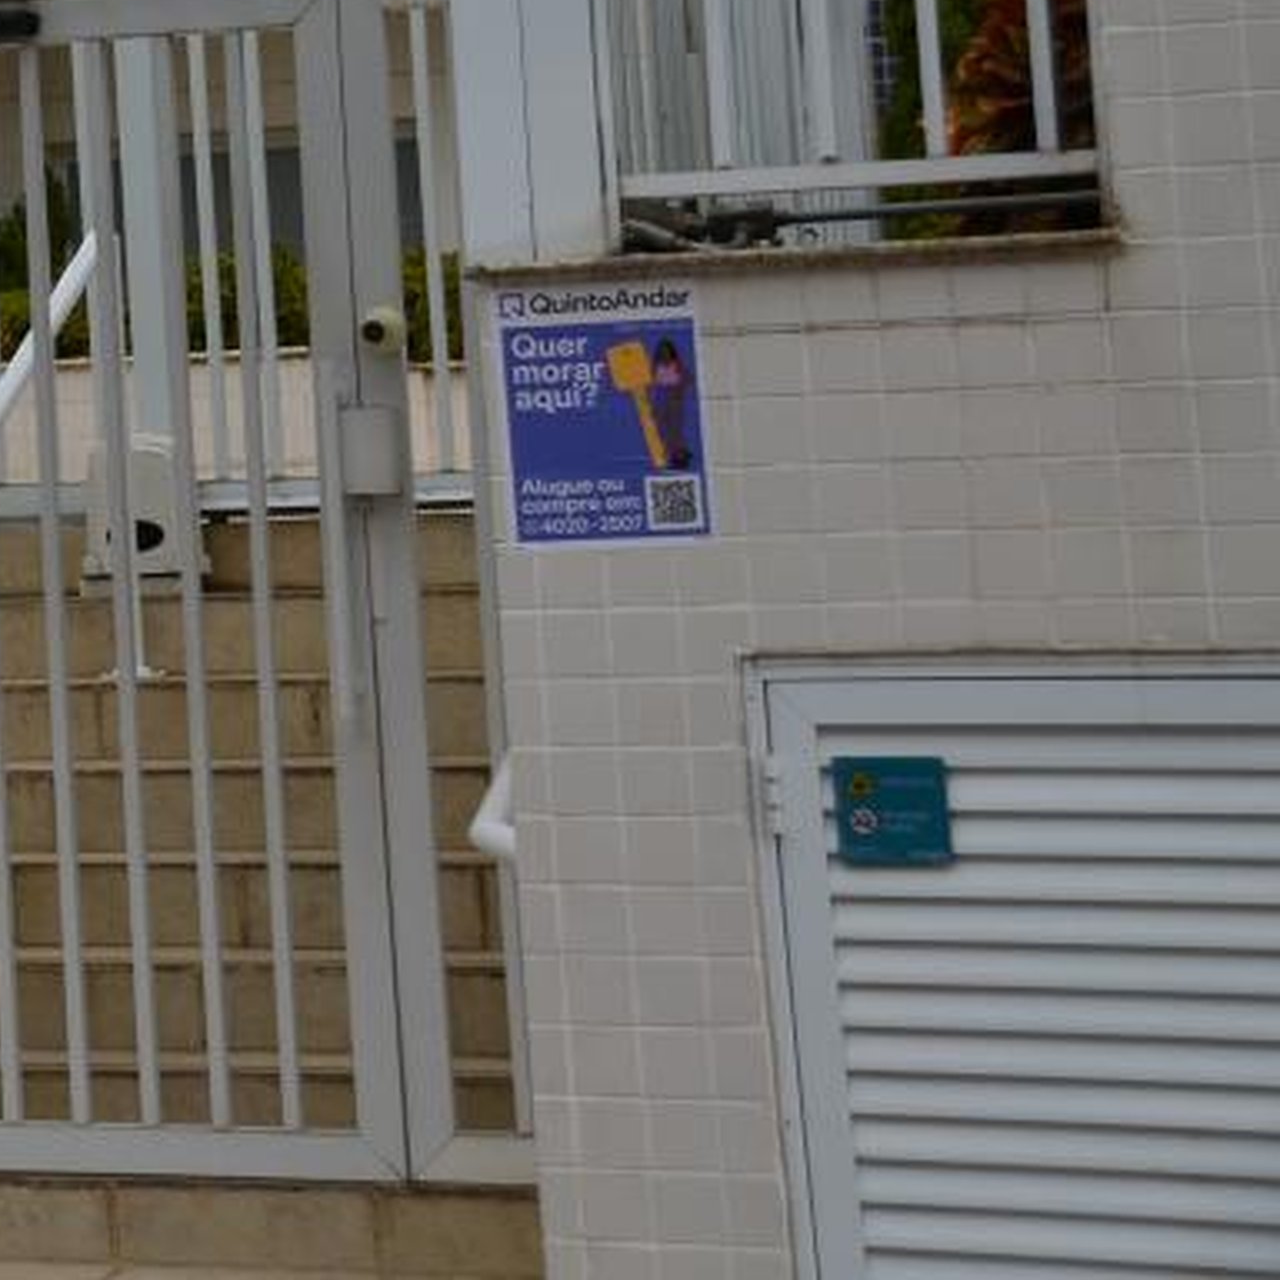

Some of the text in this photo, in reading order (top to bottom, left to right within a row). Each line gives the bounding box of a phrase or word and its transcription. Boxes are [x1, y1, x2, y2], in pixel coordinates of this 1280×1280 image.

[529, 285, 690, 315] QuintoAndar
[511, 333, 588, 360] Quer
[512, 362, 606, 385] morar
[515, 382, 600, 413] aqui?
[521, 478, 593, 497] Alugue
